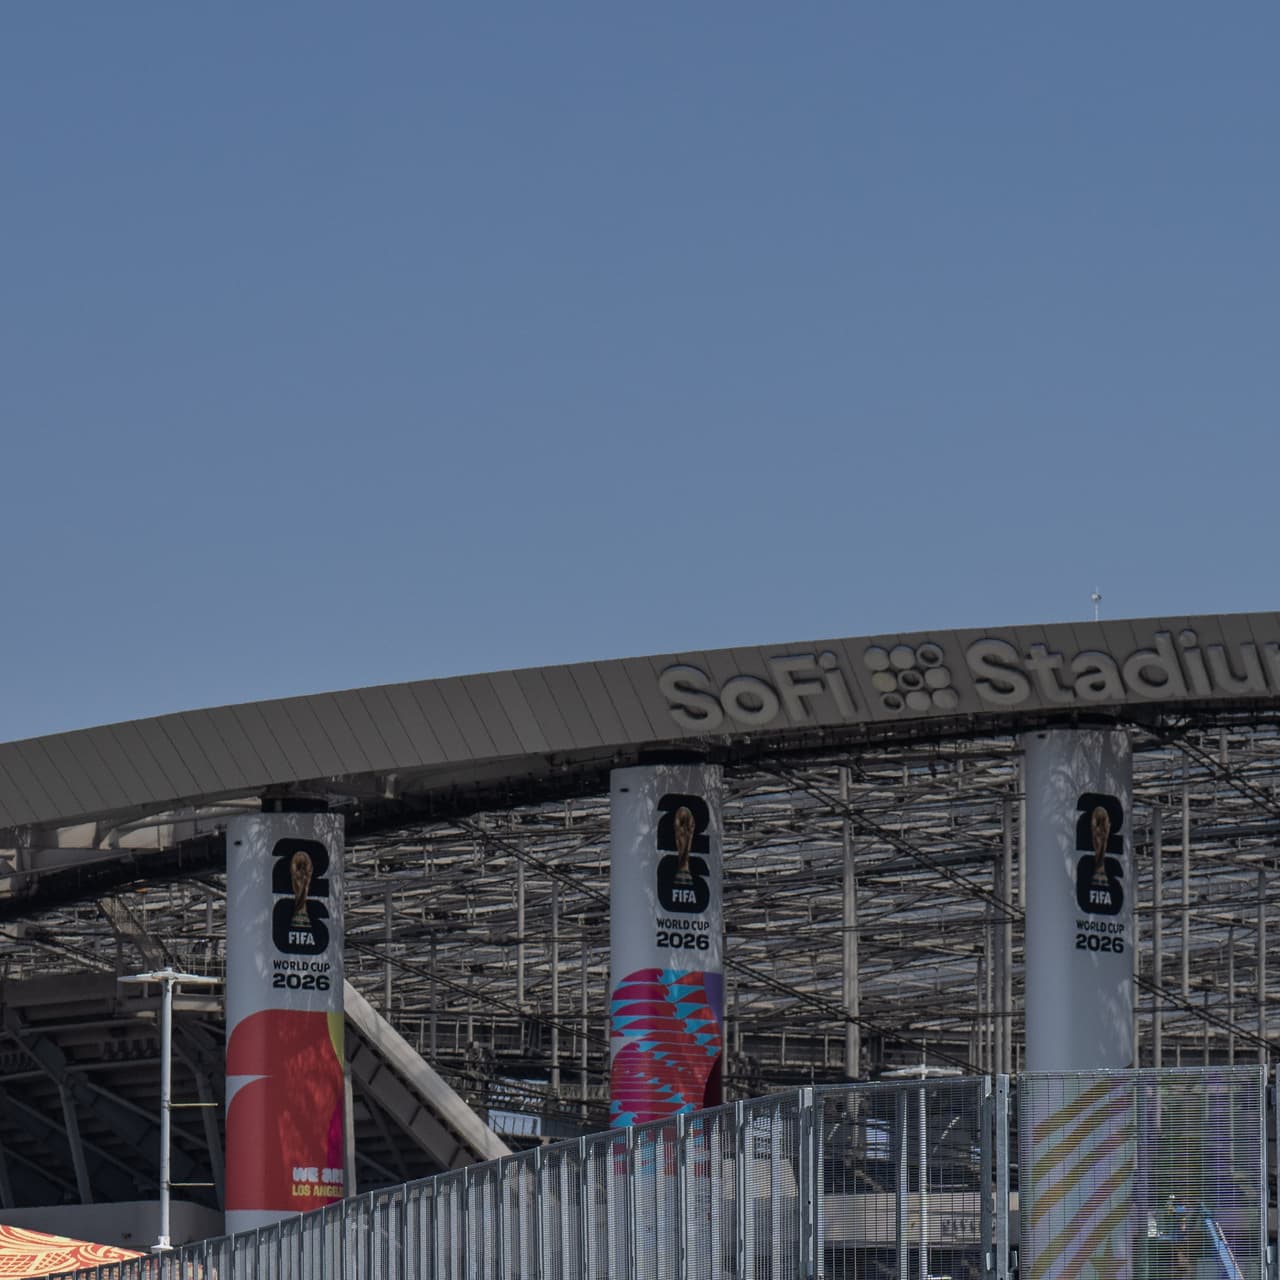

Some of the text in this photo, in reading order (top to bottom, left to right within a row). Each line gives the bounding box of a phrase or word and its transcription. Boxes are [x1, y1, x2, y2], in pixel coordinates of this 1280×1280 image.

[659, 649, 858, 731] SoFi
[672, 889, 696, 904] FIFA
[1089, 890, 1112, 905] FIFA
[656, 918, 710, 931] WORLD CUP
[1076, 919, 1124, 935] WORLD CUP
[288, 931, 315, 945] FIFA
[656, 931, 710, 950] 2026
[1076, 933, 1124, 954] 2026
[273, 960, 330, 972] WORLD CUP
[273, 973, 330, 991] 2026
[292, 1167, 319, 1183] WE
[292, 1184, 311, 1197] LOS
